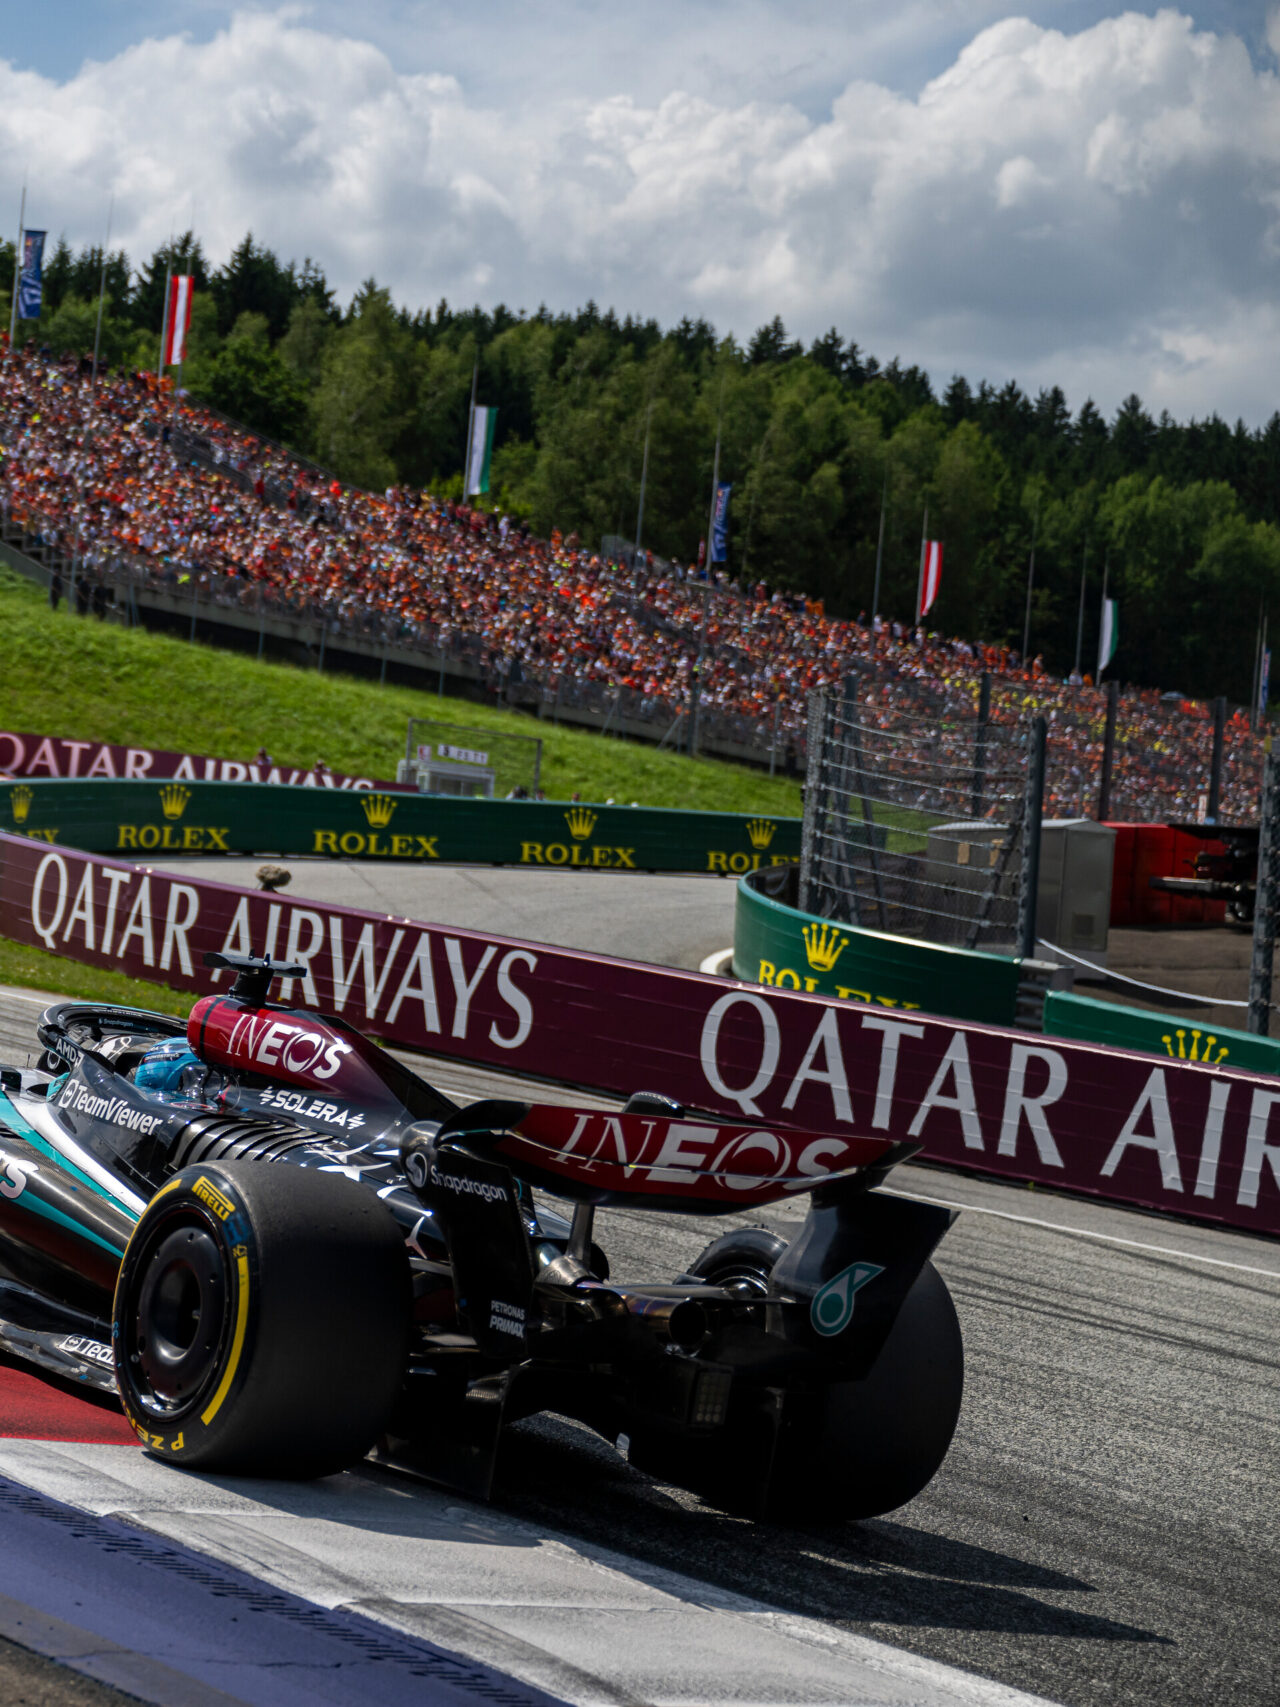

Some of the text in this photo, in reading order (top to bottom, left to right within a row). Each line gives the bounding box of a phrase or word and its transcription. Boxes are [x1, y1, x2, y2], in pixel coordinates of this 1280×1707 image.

[117, 824, 230, 851] ROLEX
[313, 829, 440, 858] ROLEX
[521, 841, 636, 868] ROLEX
[707, 851, 801, 872] ROL
[31, 852, 539, 1049] QATAR AIRWAYS
[56, 1038, 77, 1064] AMD
[226, 1013, 353, 1079] INEOS
[700, 991, 1068, 1168] QATAR
[72, 1083, 163, 1136] TeamViewer
[271, 1089, 349, 1127] SOLERA
[549, 1113, 850, 1191] INEOS
[191, 1175, 236, 1221] PIRELLI
[430, 1164, 508, 1202] Snapdragon
[489, 1315, 525, 1339] PRIMAX
[490, 1300, 525, 1320] PETRONAS
